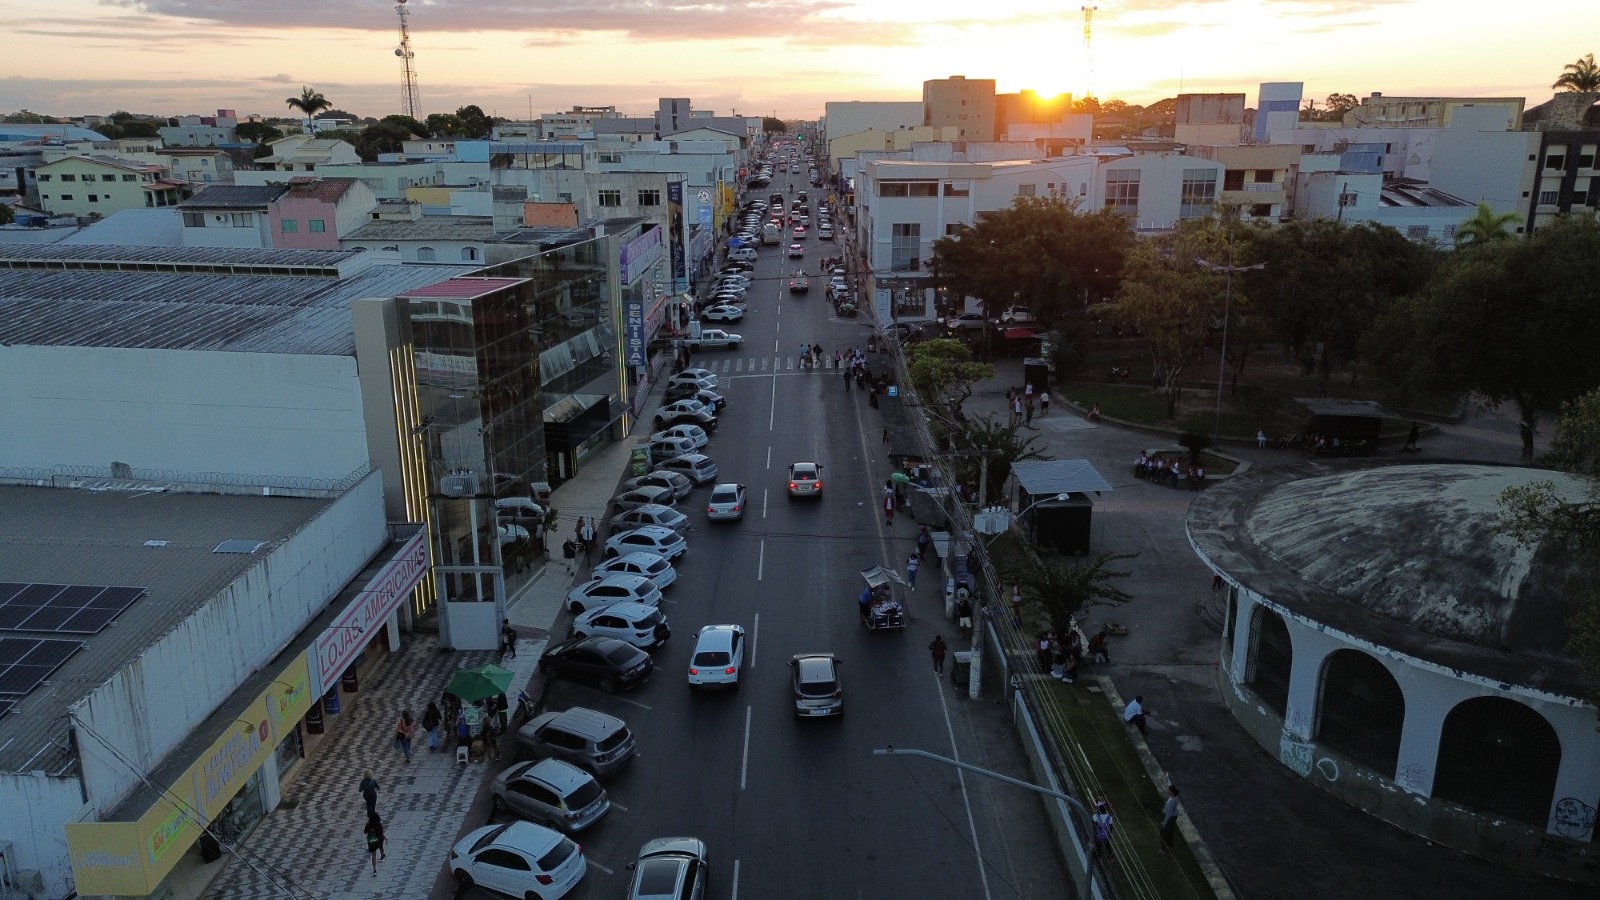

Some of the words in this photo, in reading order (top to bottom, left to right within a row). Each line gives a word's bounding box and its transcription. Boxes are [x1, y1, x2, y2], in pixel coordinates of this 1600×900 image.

[629, 303, 642, 359] DENTISTA
[320, 617, 362, 677] LOJAS
[364, 544, 426, 628] AMERICANAS
